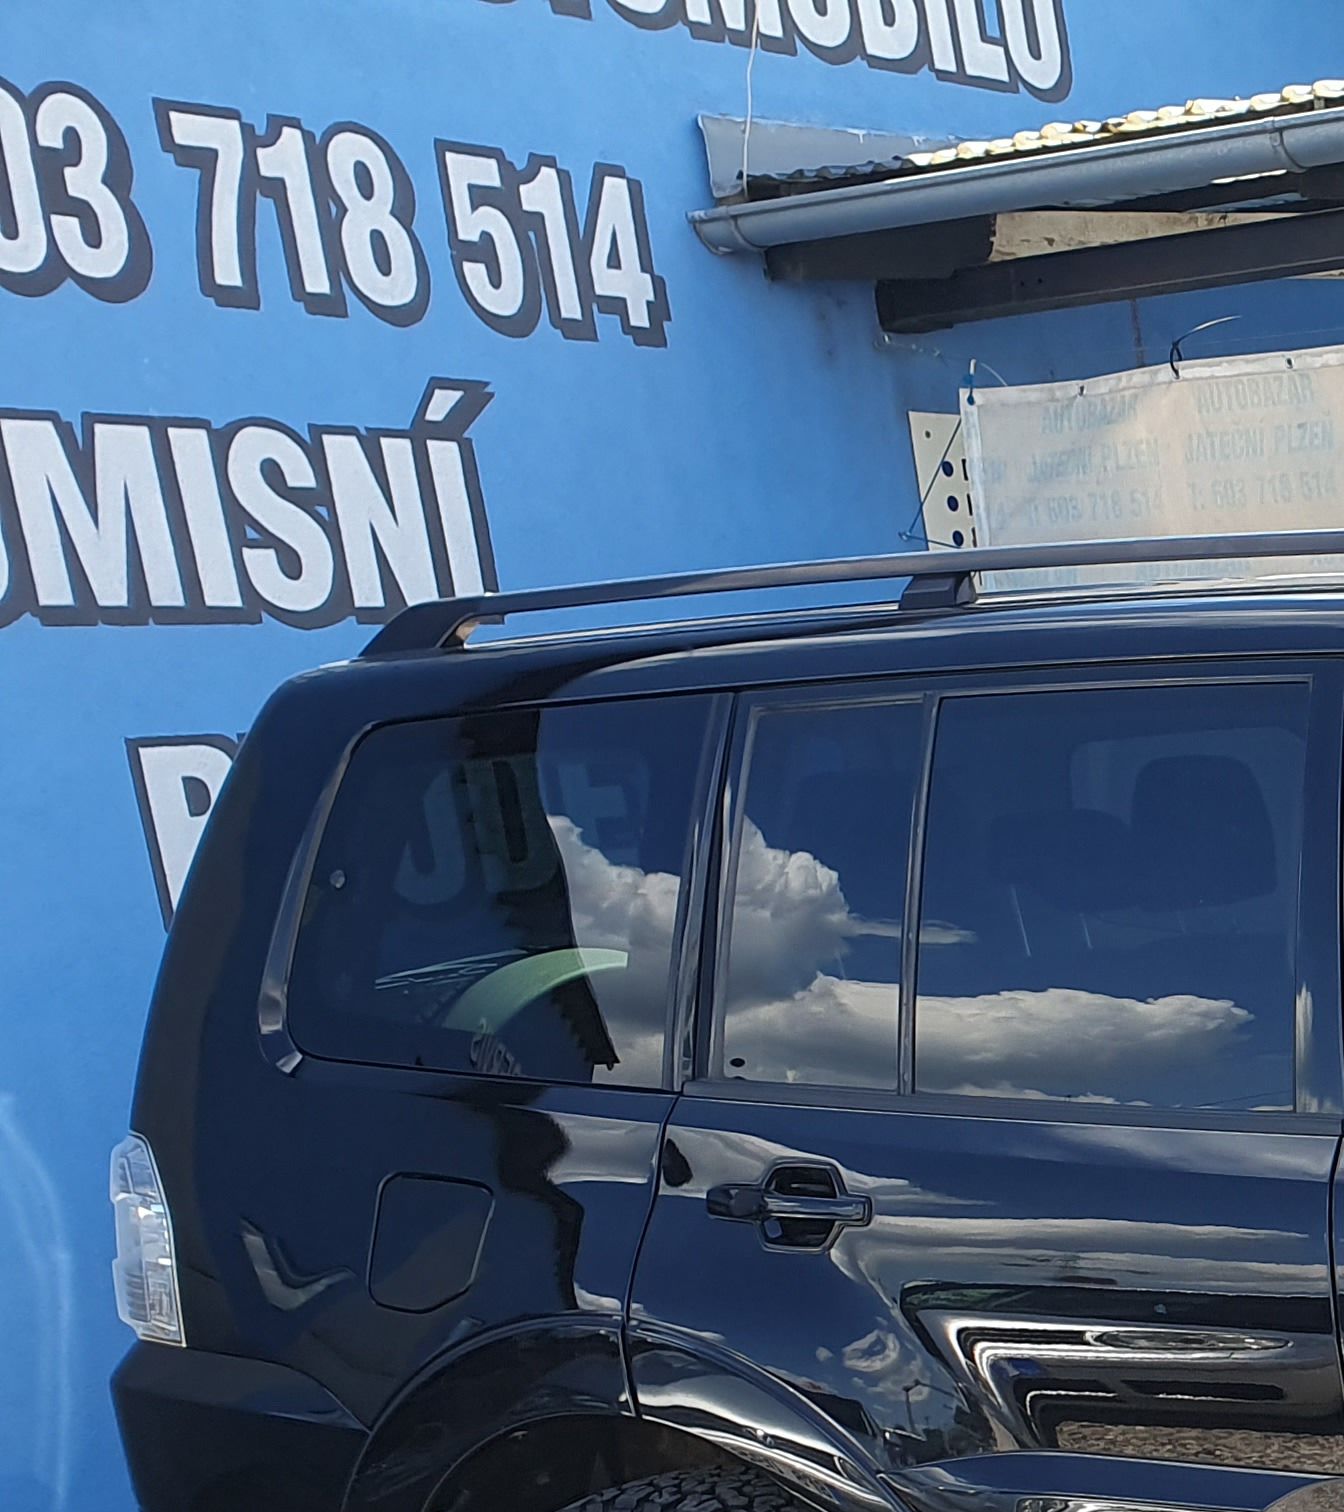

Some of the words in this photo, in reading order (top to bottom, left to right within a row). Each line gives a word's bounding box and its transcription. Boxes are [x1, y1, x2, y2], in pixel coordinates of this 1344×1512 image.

[152, 97, 430, 328] 718
[434, 138, 671, 347] 514
[0, 377, 505, 632] MISNÍ
